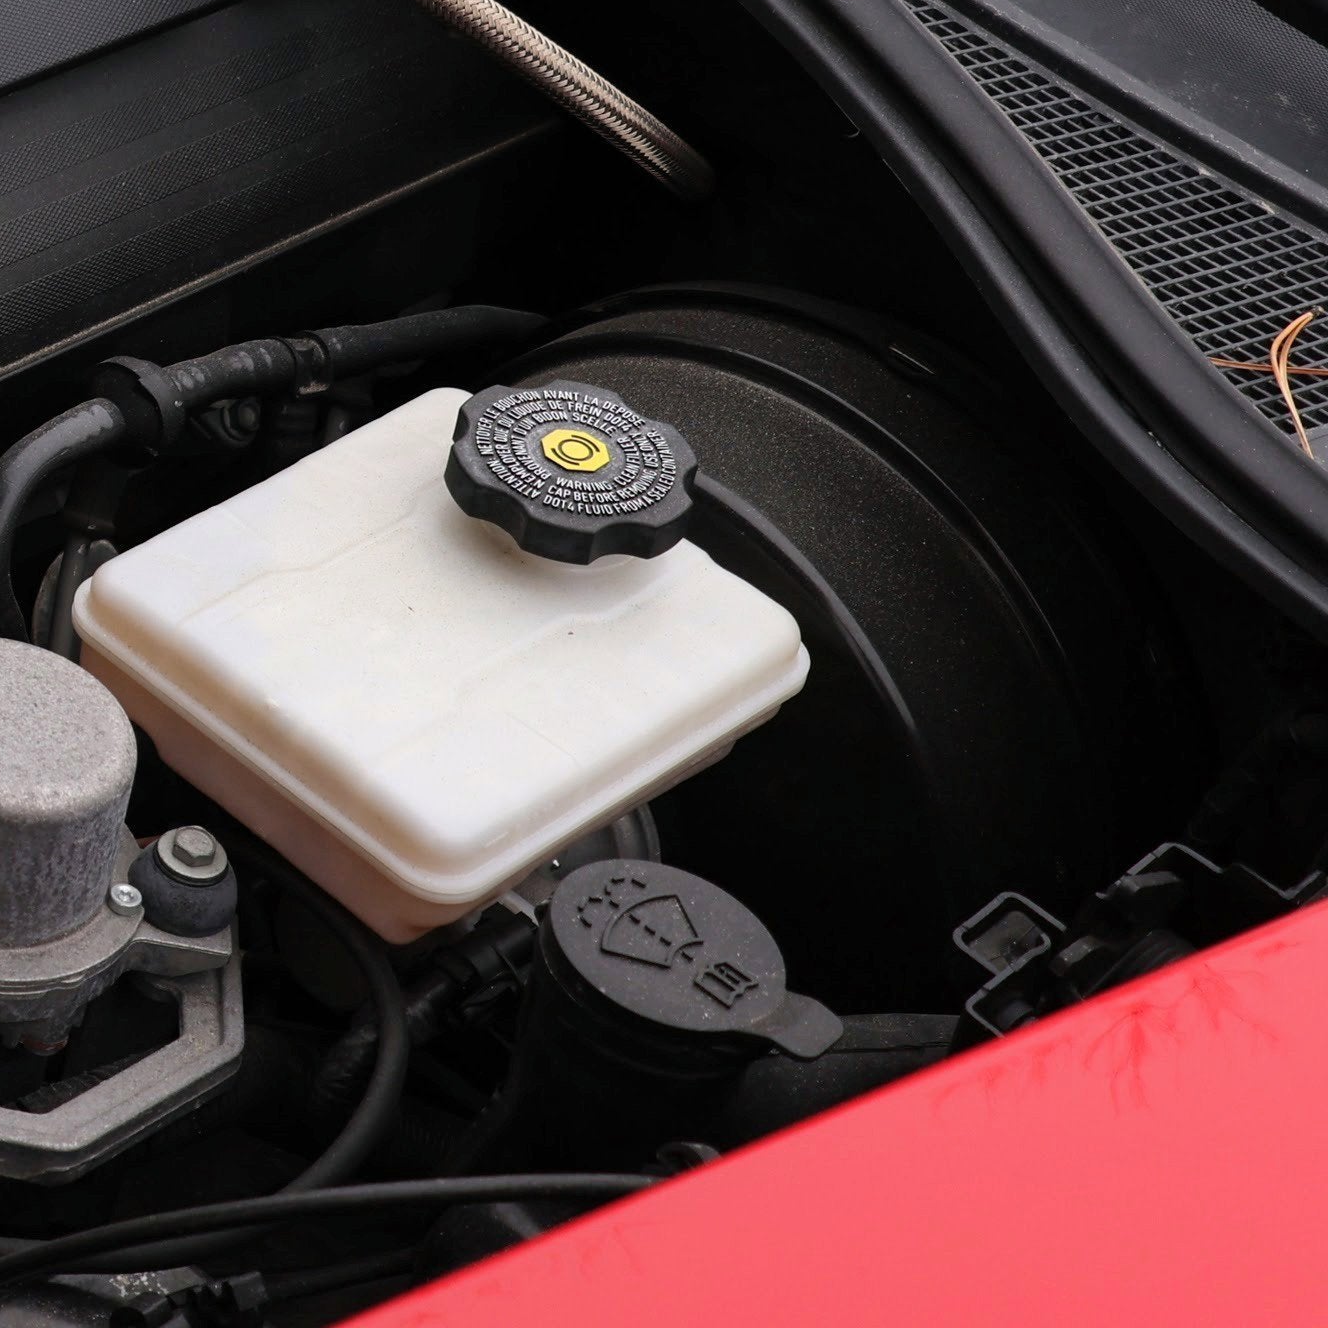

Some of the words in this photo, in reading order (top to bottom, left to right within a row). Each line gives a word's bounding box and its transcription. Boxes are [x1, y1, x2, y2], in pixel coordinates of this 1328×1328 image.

[493, 390, 541, 412] BOUCHON
[543, 390, 579, 401] AVANT
[584, 394, 599, 406] LA
[484, 408, 501, 420] LE
[508, 400, 545, 420] LIQUIDE
[547, 400, 565, 411] DE
[567, 401, 603, 418] FREIN
[498, 415, 515, 429] DU
[532, 410, 568, 424] BIDON
[603, 412, 633, 432] DOT4
[476, 416, 494, 456] NETTOYER
[493, 427, 509, 443] QUE
[629, 431, 655, 452] ONLY
[617, 437, 640, 464] FILLER
[642, 452, 659, 469] USE
[613, 464, 641, 487] CLEAN
[547, 484, 572, 499] CAP
[647, 472, 675, 501] SEALED
[543, 494, 575, 513] DOT4
[573, 491, 620, 504] BEFORE
[613, 497, 648, 514] FROM
[642, 494, 655, 506] A
[577, 503, 613, 515] FLUID
